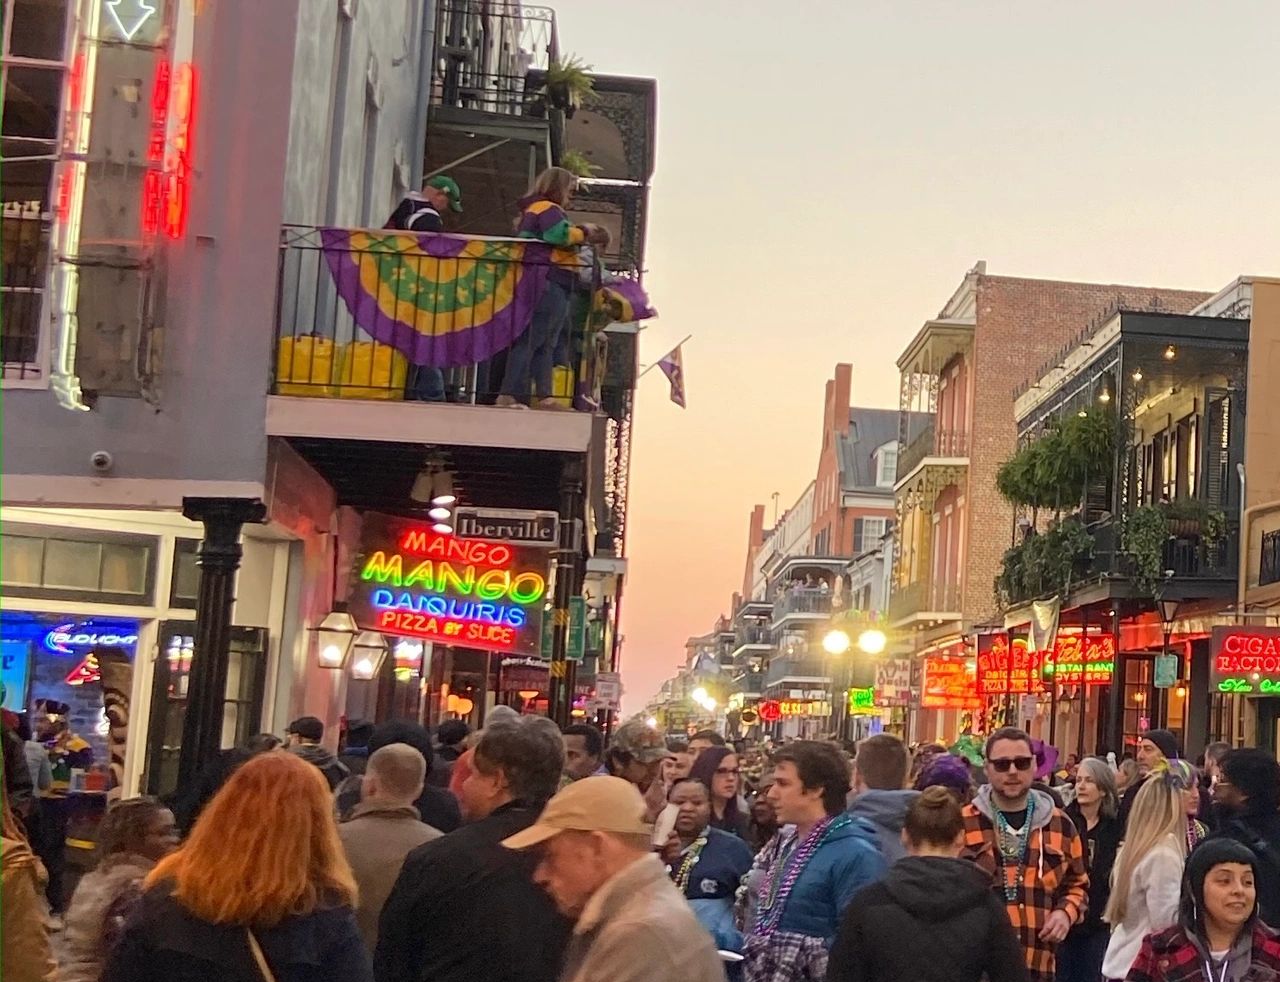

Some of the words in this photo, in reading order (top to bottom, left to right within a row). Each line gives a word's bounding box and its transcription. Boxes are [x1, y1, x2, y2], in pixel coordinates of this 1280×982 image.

[461, 518, 551, 538] Iberville
[404, 531, 510, 565] MANGO
[361, 551, 545, 604] MANGO
[374, 589, 526, 627] DAIQUIRIS
[54, 633, 92, 644] BUD
[92, 633, 138, 645] LIGHT
[382, 611, 439, 634] PIZZA
[443, 621, 463, 635] BY
[467, 625, 513, 644] SLICE
[1218, 679, 1253, 692] New
